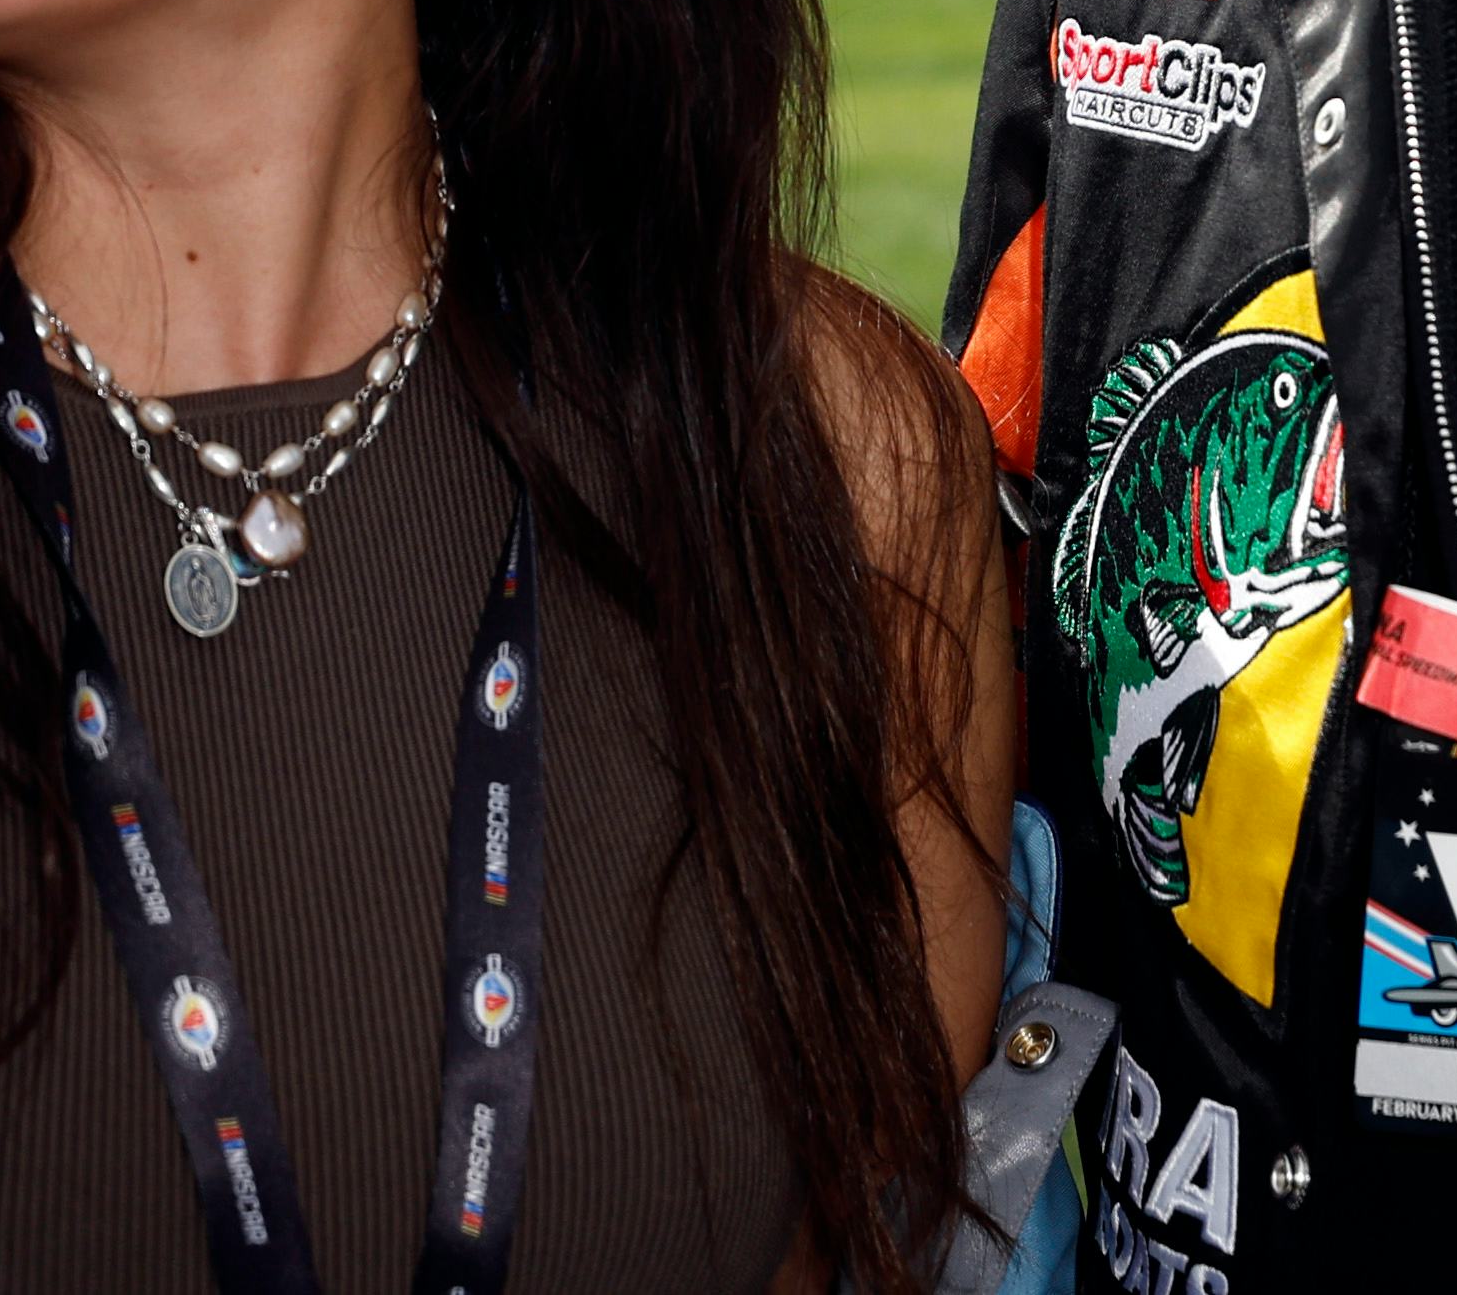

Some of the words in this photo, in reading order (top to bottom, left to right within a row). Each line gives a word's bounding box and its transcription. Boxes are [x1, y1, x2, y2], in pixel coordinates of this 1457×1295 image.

[1077, 89, 1202, 137] HAIRCUTS
[485, 781, 510, 876] NASCAR
[121, 831, 171, 925] NASCAR
[223, 1147, 269, 1246] NASCAR
[464, 1102, 496, 1206] NASCAR
